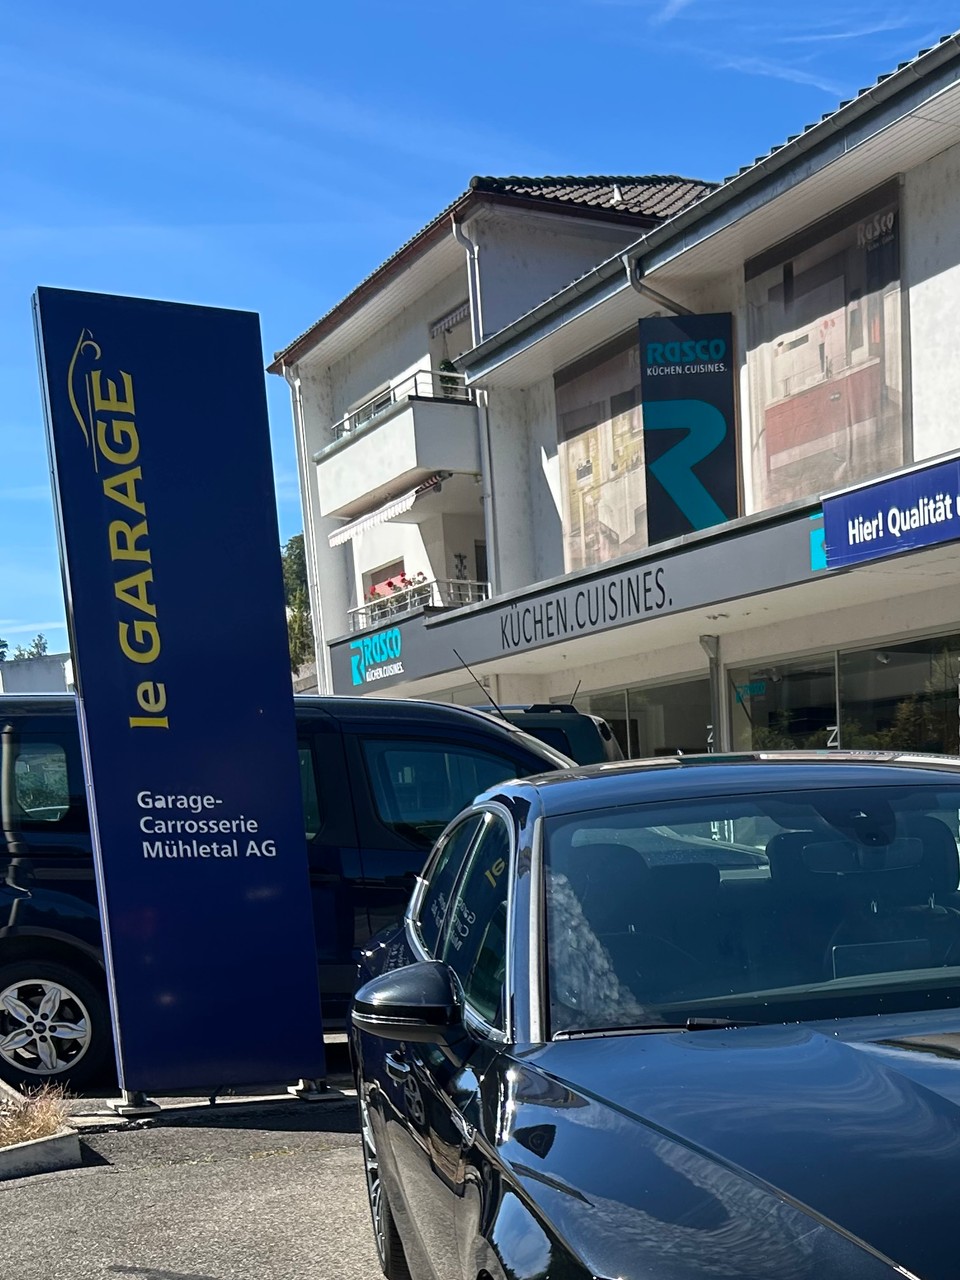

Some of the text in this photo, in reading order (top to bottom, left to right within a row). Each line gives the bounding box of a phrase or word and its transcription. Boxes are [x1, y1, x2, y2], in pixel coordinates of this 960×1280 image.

[646, 363, 728, 376] KÜCHEN.CUISINES.
[848, 512, 884, 545] Hier!
[888, 494, 952, 536] Qualität
[91, 369, 169, 729] le GARAGE
[500, 567, 673, 650] KÜCHEN.CUISINES.
[136, 791, 223, 813] Garage-
[139, 815, 258, 833] Carrosserie
[142, 839, 277, 858] Mühletal AG
